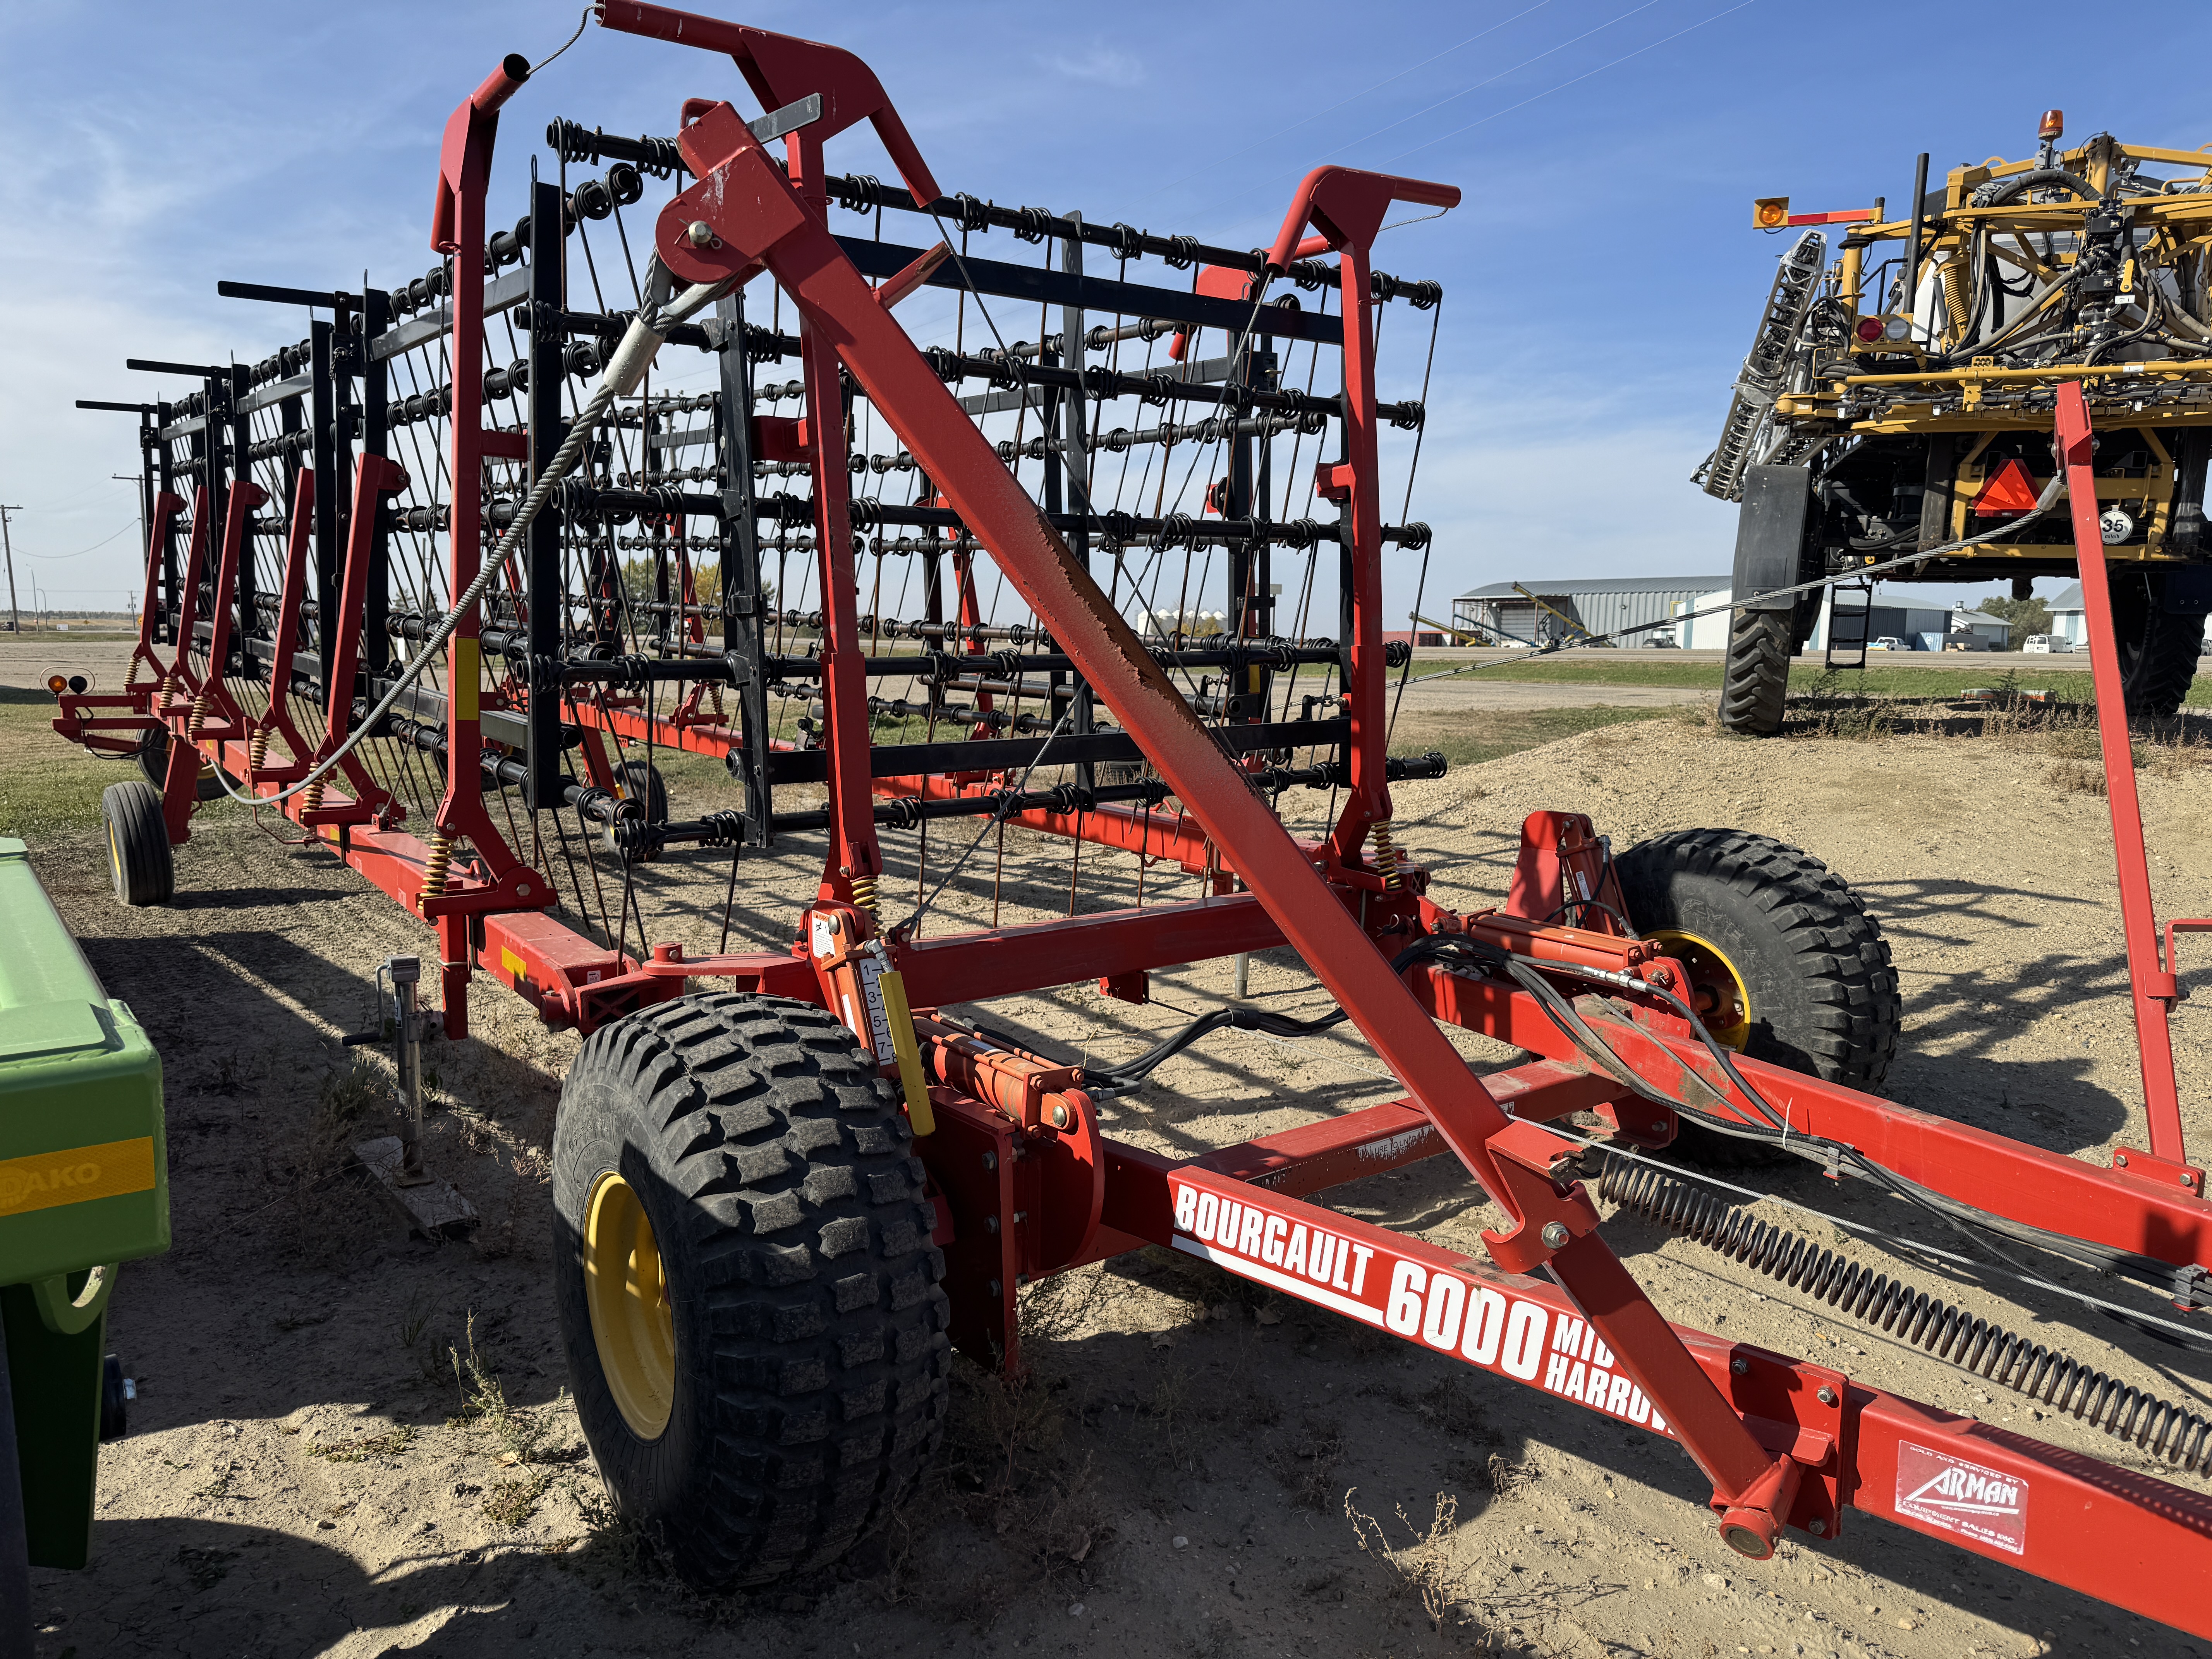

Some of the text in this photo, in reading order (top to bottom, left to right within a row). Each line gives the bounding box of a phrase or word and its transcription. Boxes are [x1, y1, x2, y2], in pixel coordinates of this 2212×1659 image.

[2102, 519, 2124, 532] 35
[864, 964, 869, 975] 1
[868, 991, 876, 1003] 3
[874, 1015, 881, 1027] 5
[878, 1042, 885, 1054] 7
[892, 1052, 898, 1063] 8
[1174, 1184, 1548, 1381] BOURGAULT 6000
[1910, 1446, 1933, 1456] SOLD
[1936, 1455, 1954, 1463] AND
[1958, 1462, 2002, 1479] SERVICED
[1903, 1465, 2018, 1506] ARMAN
[1903, 1500, 1960, 1524] EQUIPMENT
[1961, 1521, 1995, 1537] SALES
